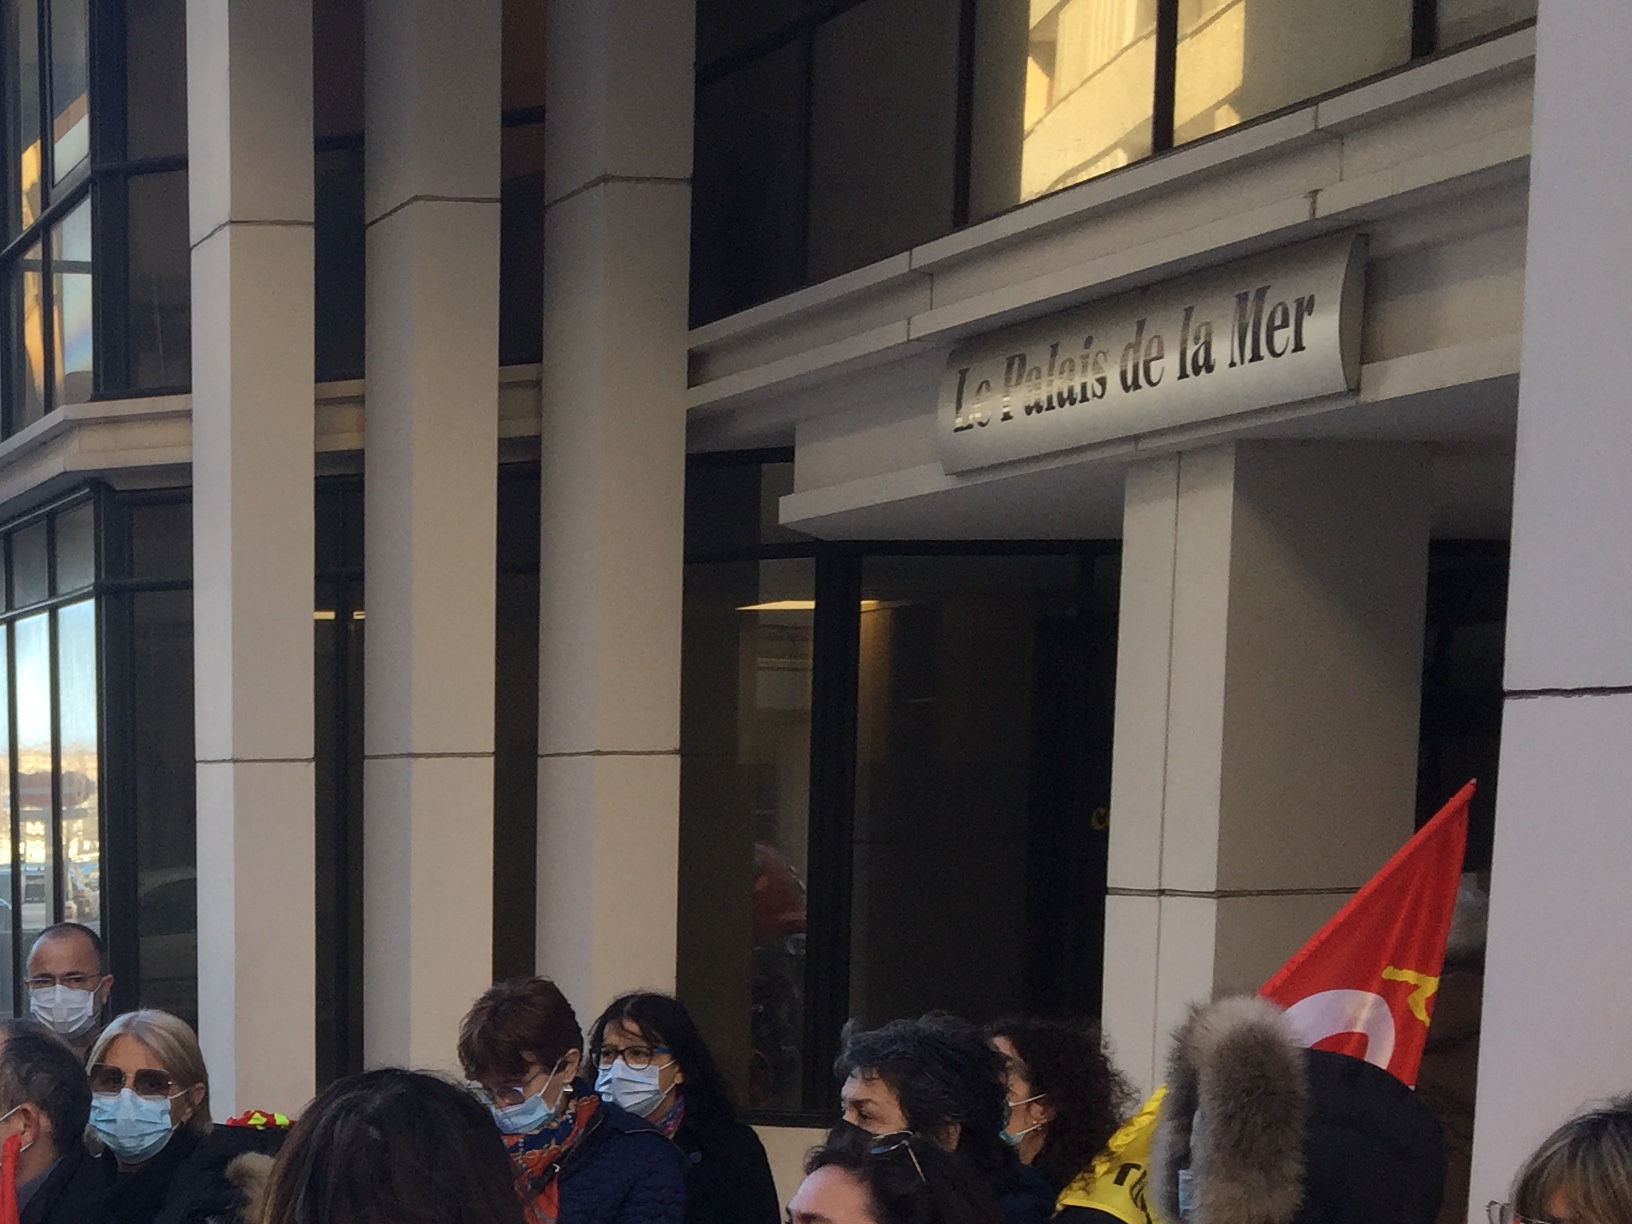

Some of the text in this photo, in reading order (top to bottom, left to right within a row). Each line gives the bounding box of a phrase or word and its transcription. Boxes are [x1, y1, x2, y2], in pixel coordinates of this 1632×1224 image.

[953, 284, 1316, 433] Le Palais de la Mer
